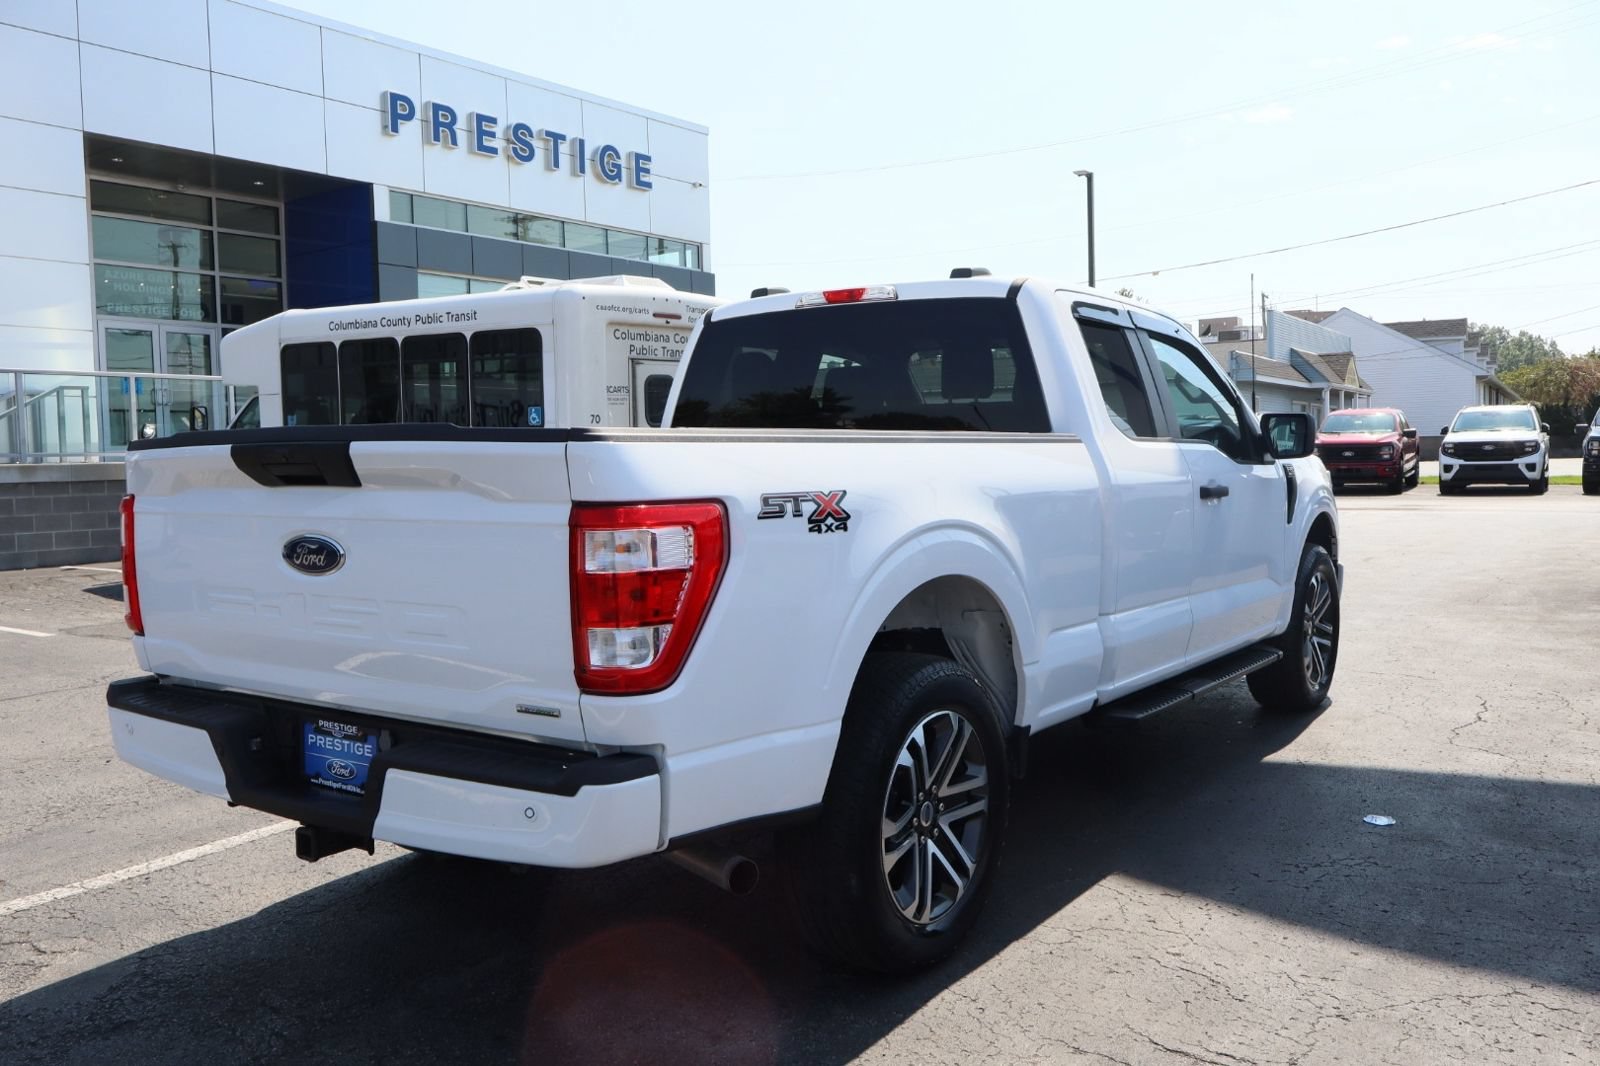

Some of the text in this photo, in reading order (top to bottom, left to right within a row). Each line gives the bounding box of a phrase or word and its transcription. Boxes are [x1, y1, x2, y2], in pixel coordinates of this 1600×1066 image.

[385, 90, 653, 190] PRESTIGE
[106, 303, 169, 316] PRESTIGE
[328, 310, 478, 332] Columbiana County Public Transit
[613, 328, 670, 343] Columbiana
[629, 344, 658, 356] Public
[590, 414, 601, 424] 70
[757, 489, 851, 525] STX
[293, 542, 328, 567] Ford
[319, 719, 358, 733] PRESTIGE
[308, 734, 373, 757] PRESTIGE
[331, 761, 350, 776] Ford
